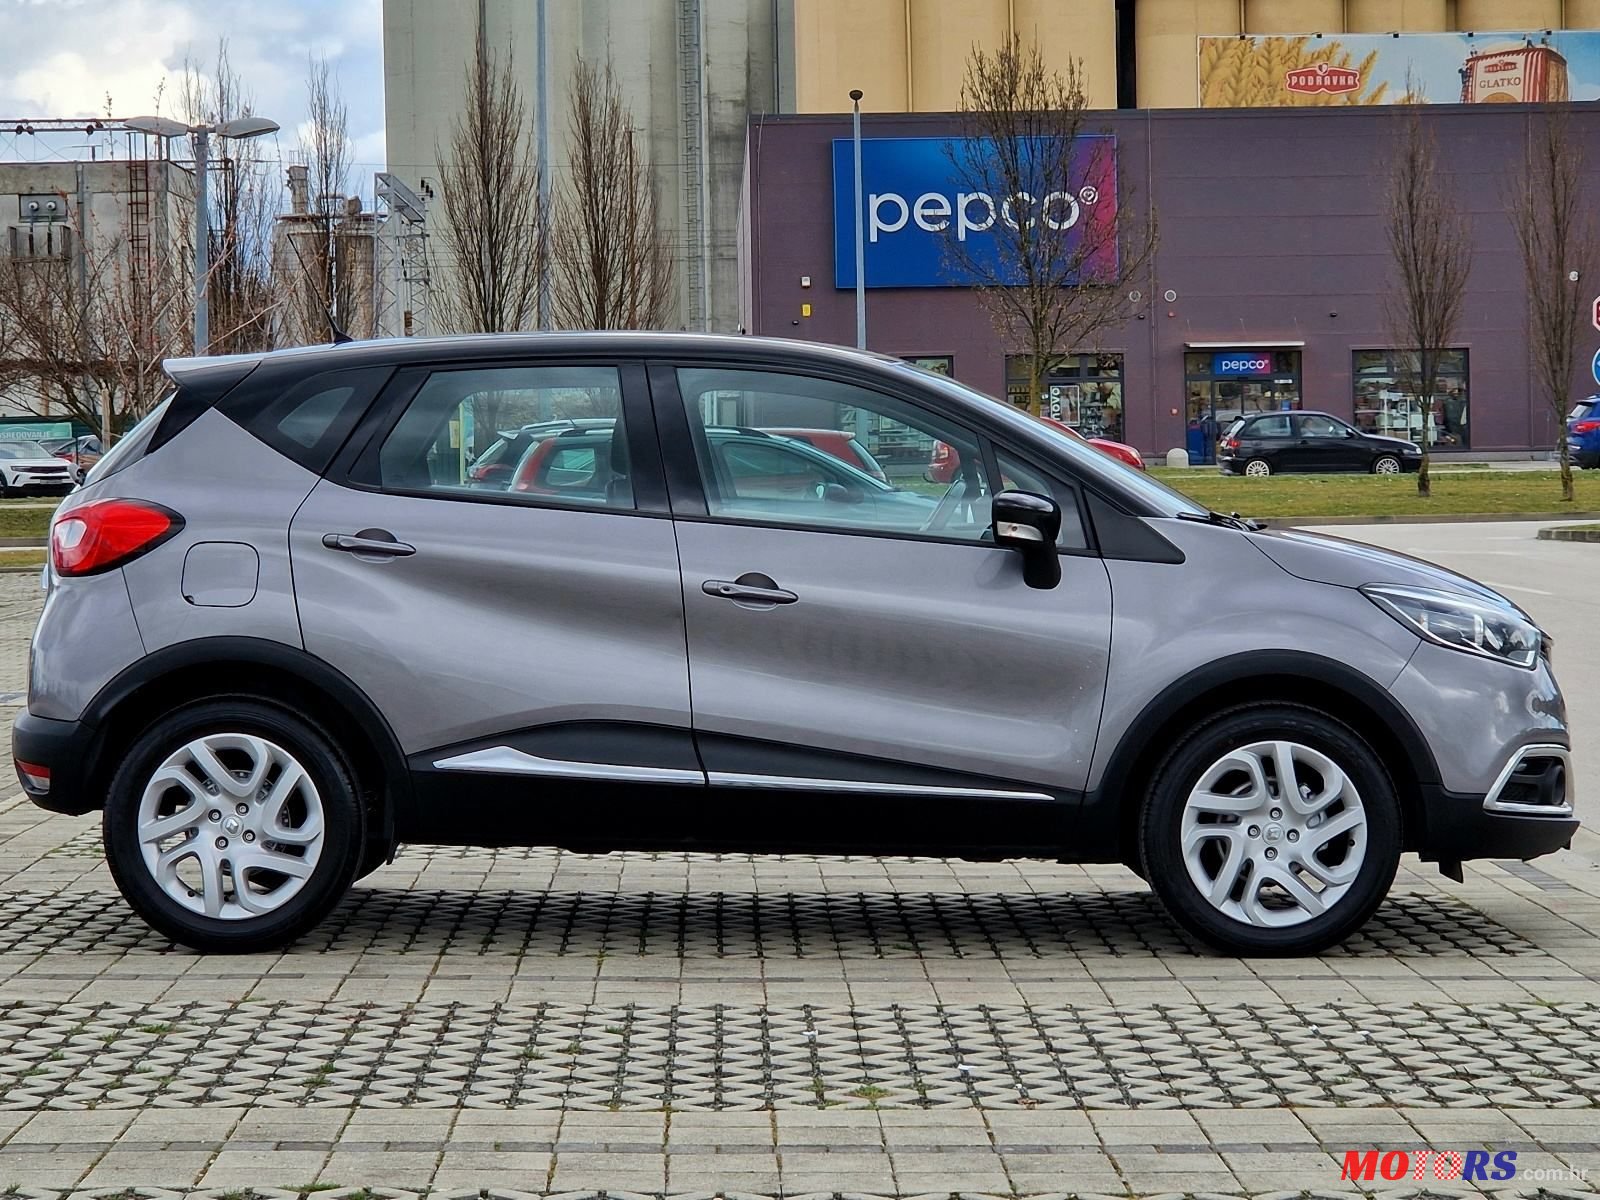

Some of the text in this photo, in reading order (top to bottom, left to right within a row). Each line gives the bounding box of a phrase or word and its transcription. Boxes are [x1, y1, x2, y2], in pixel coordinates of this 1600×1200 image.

[1291, 75, 1354, 86] PODRAVKA
[1479, 76, 1521, 89] GLATKO
[868, 191, 1080, 243] pepco
[1221, 359, 1265, 372] pepco
[1051, 387, 1061, 421] novo
[0, 431, 50, 439] SREDOVANJE
